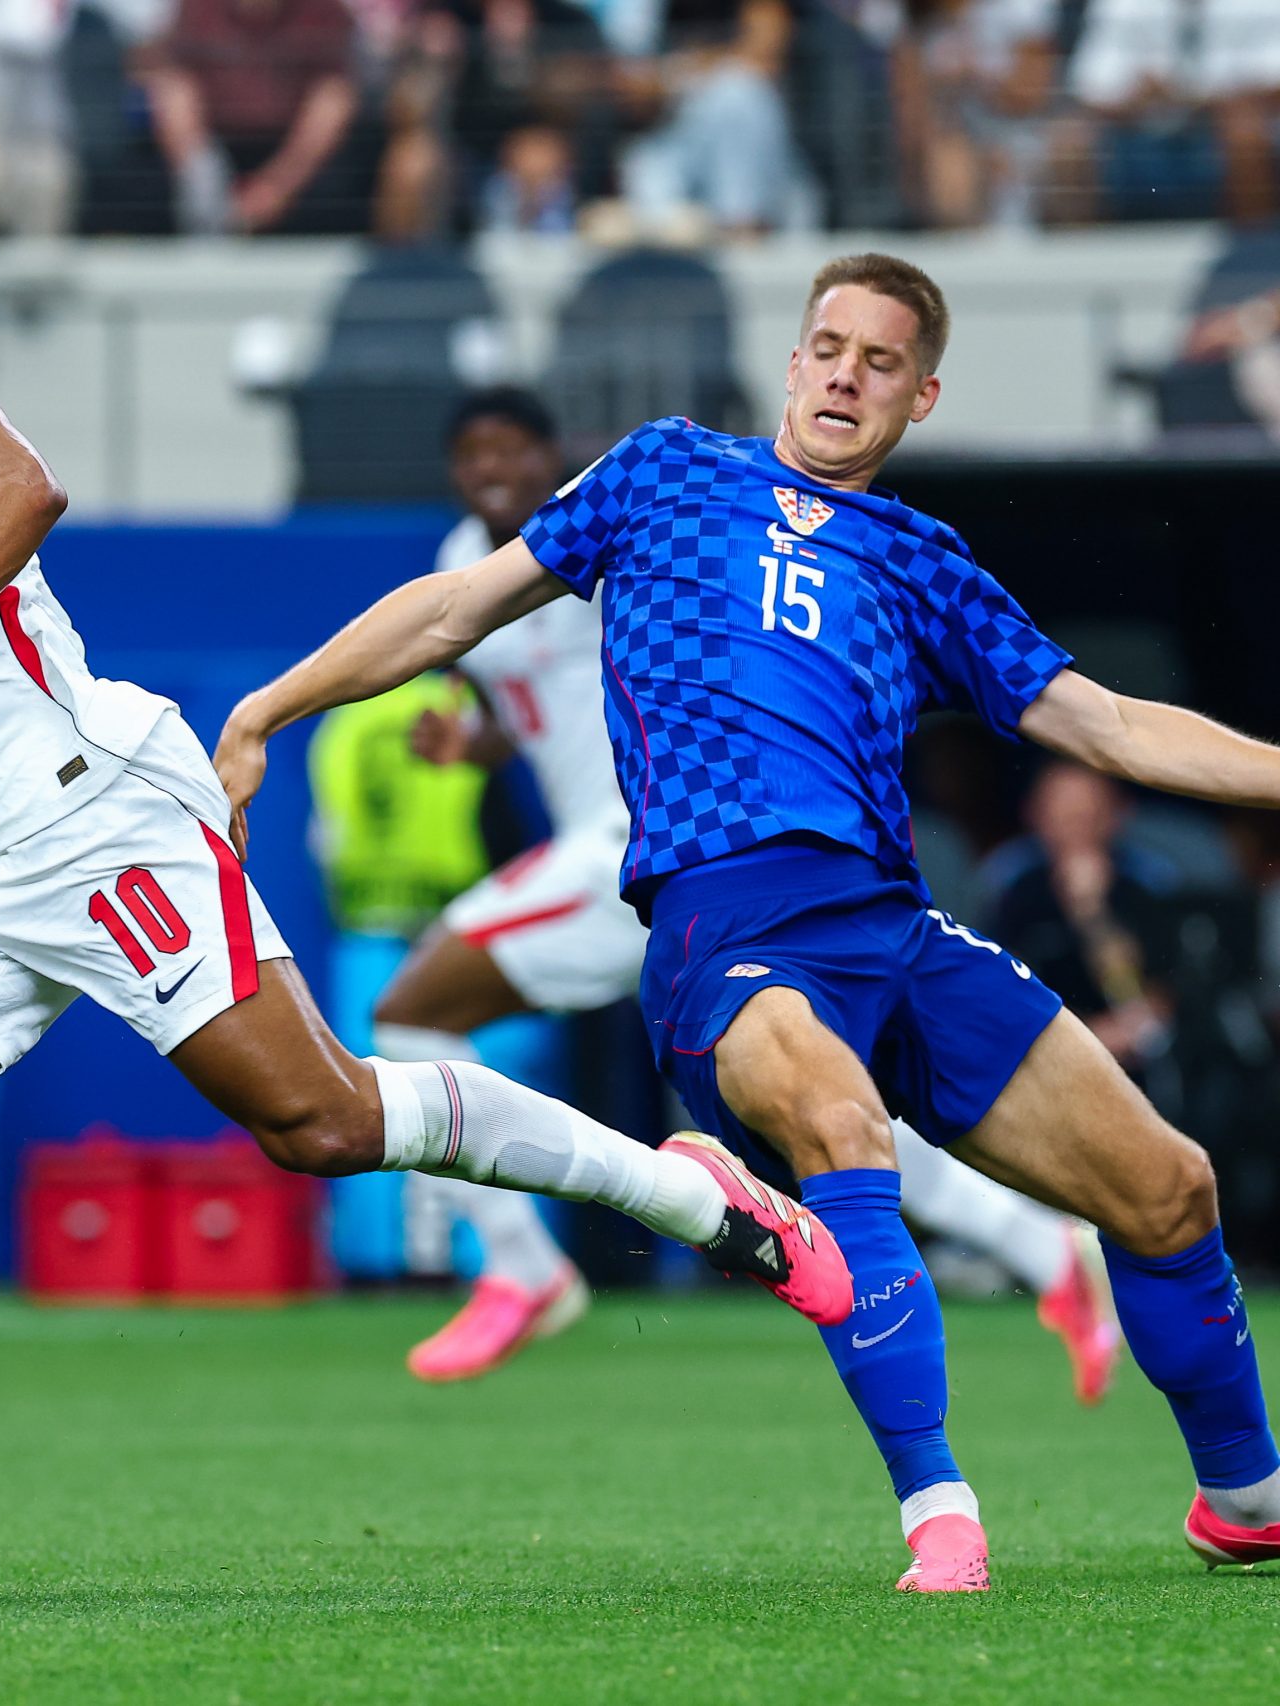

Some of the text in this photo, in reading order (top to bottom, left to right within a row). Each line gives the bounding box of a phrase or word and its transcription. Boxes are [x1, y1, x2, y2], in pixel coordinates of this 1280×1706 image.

[759, 555, 826, 641] 15
[88, 866, 192, 979] 10
[852, 1276, 907, 1313] HNS
